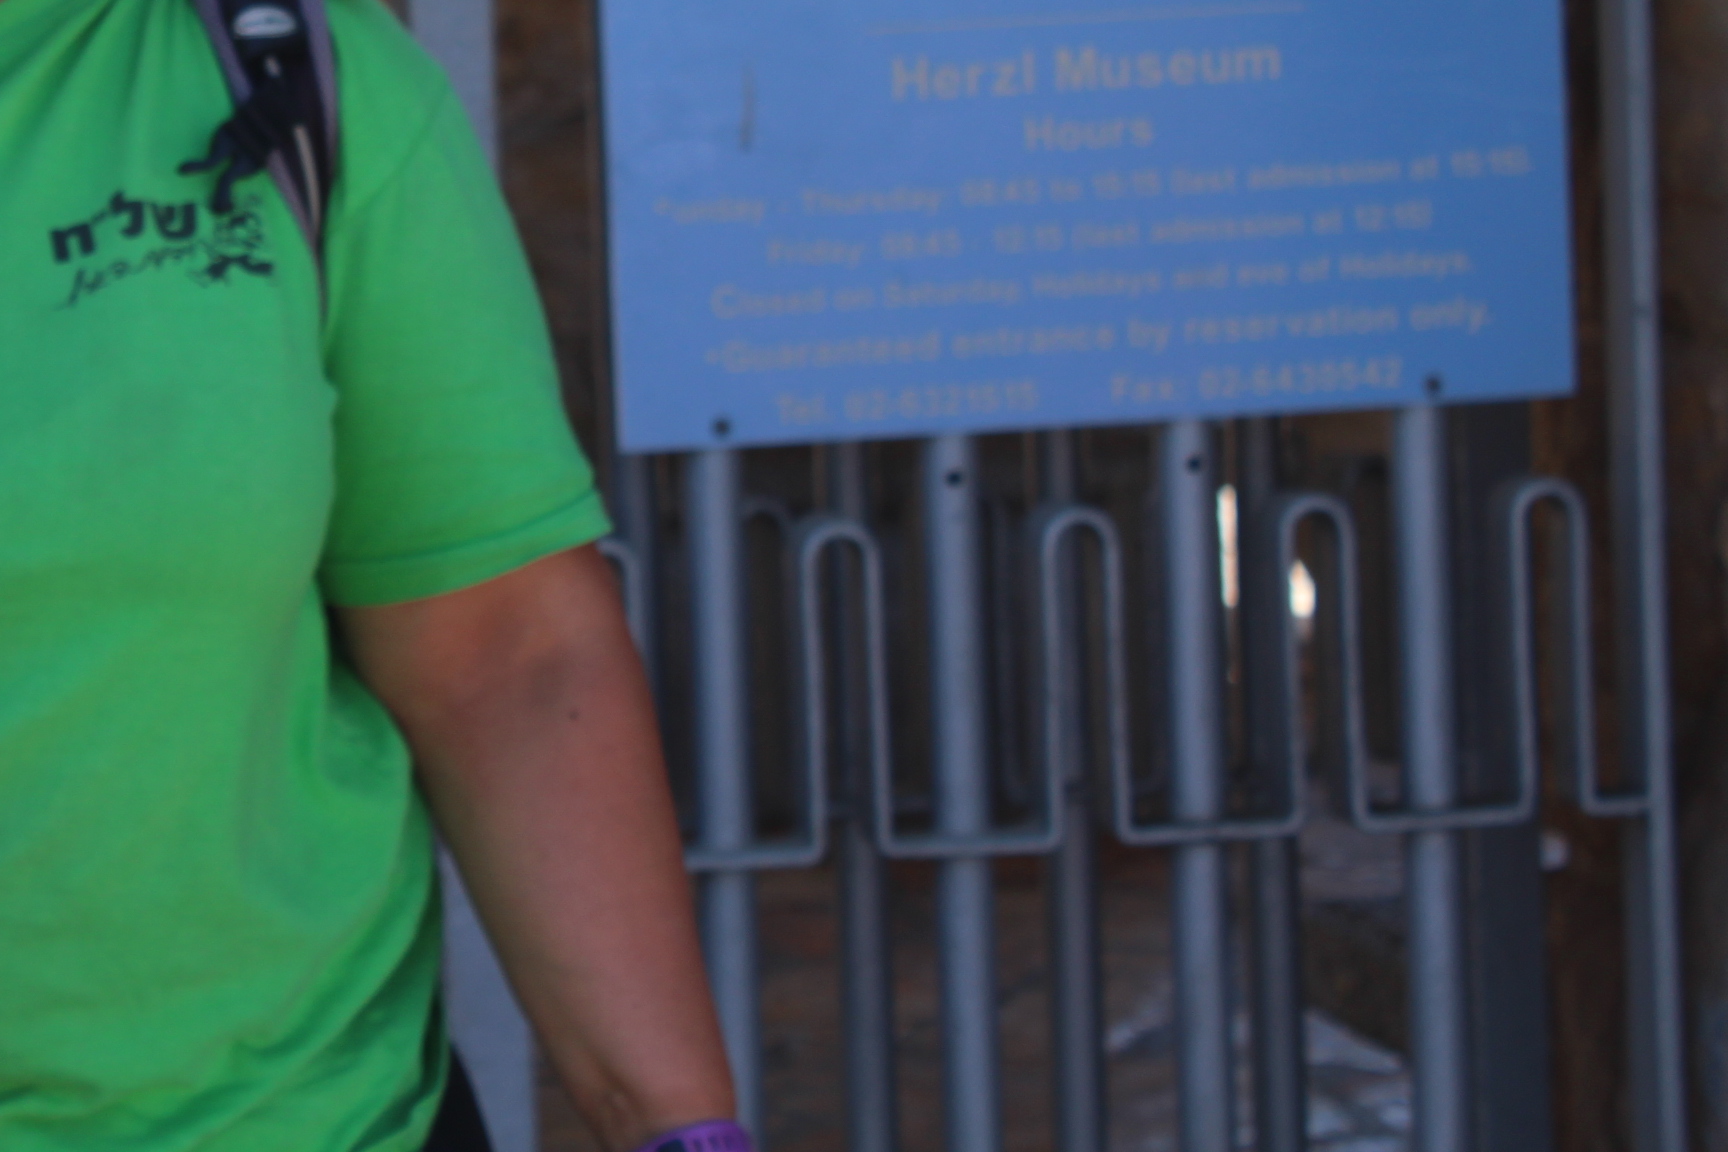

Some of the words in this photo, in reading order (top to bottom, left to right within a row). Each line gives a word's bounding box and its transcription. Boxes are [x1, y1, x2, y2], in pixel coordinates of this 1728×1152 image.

[889, 52, 1036, 102] Herzl
[1054, 44, 1283, 94] Museum
[1023, 112, 1155, 152] Hours
[709, 283, 828, 319] Closed
[833, 285, 875, 312] on
[1030, 268, 1164, 301] Holidays
[1174, 261, 1230, 291] and
[1237, 261, 1290, 287] eve
[1298, 255, 1332, 283] of
[951, 325, 1117, 360] entrance
[1127, 317, 1172, 355] by
[1183, 305, 1399, 345] reservation
